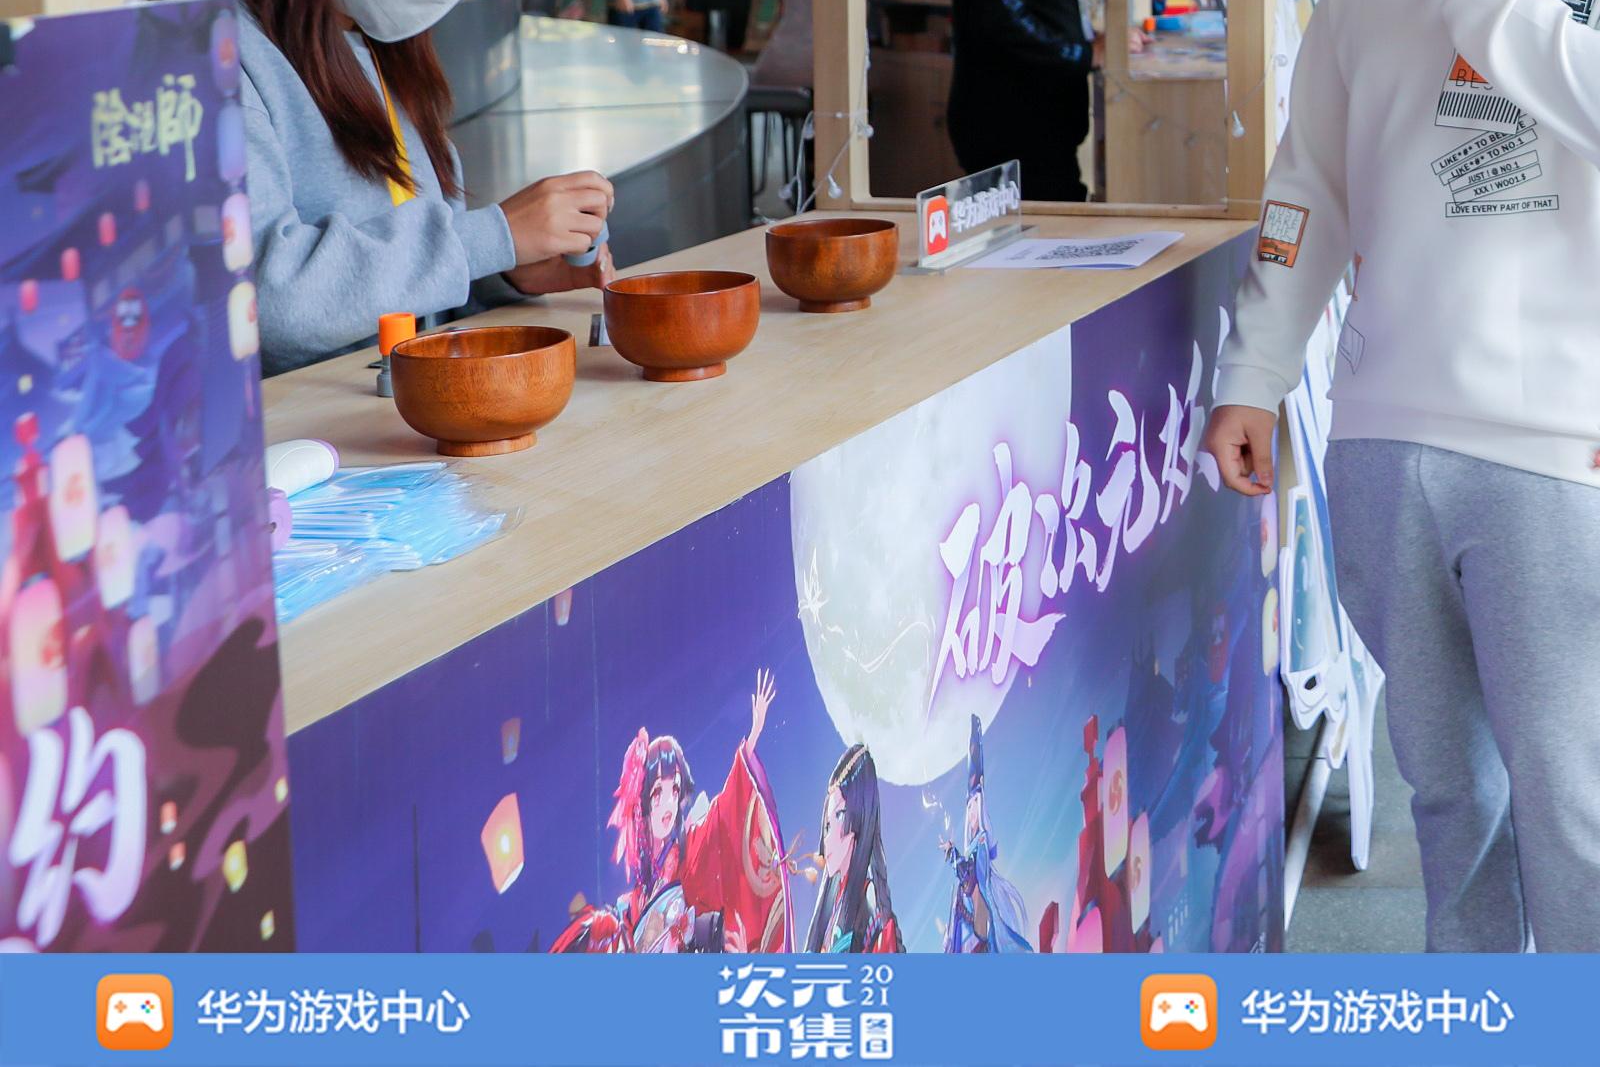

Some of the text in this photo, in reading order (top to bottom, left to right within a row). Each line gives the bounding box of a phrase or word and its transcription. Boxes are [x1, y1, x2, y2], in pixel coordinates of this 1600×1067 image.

[1455, 68, 1494, 91] BE
[1486, 148, 1500, 159] TO
[1468, 171, 1485, 184] JUST
[1451, 205, 1470, 214] LOVE
[1472, 204, 1498, 213] EVERY
[1500, 203, 1519, 212] PART
[1533, 199, 1552, 209] THAT
[8, 705, 148, 949] 约
